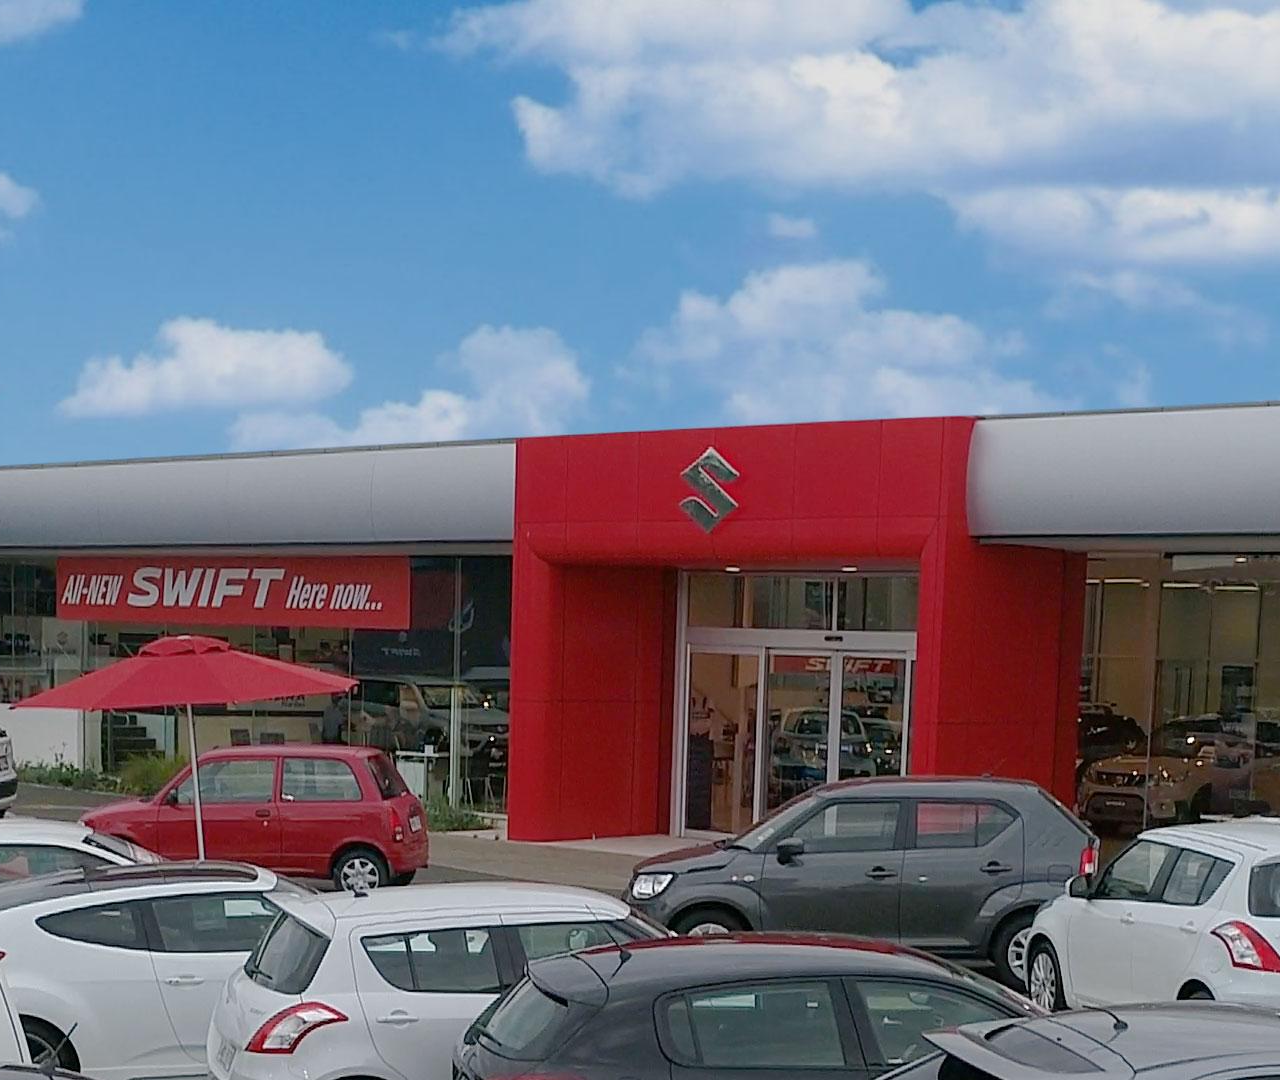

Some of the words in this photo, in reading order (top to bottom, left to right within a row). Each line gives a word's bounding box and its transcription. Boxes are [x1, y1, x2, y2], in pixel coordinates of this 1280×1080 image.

[127, 567, 285, 609] SWIFT
[285, 576, 327, 610] Here
[329, 582, 384, 610] now...
[805, 658, 891, 672] SIFT
